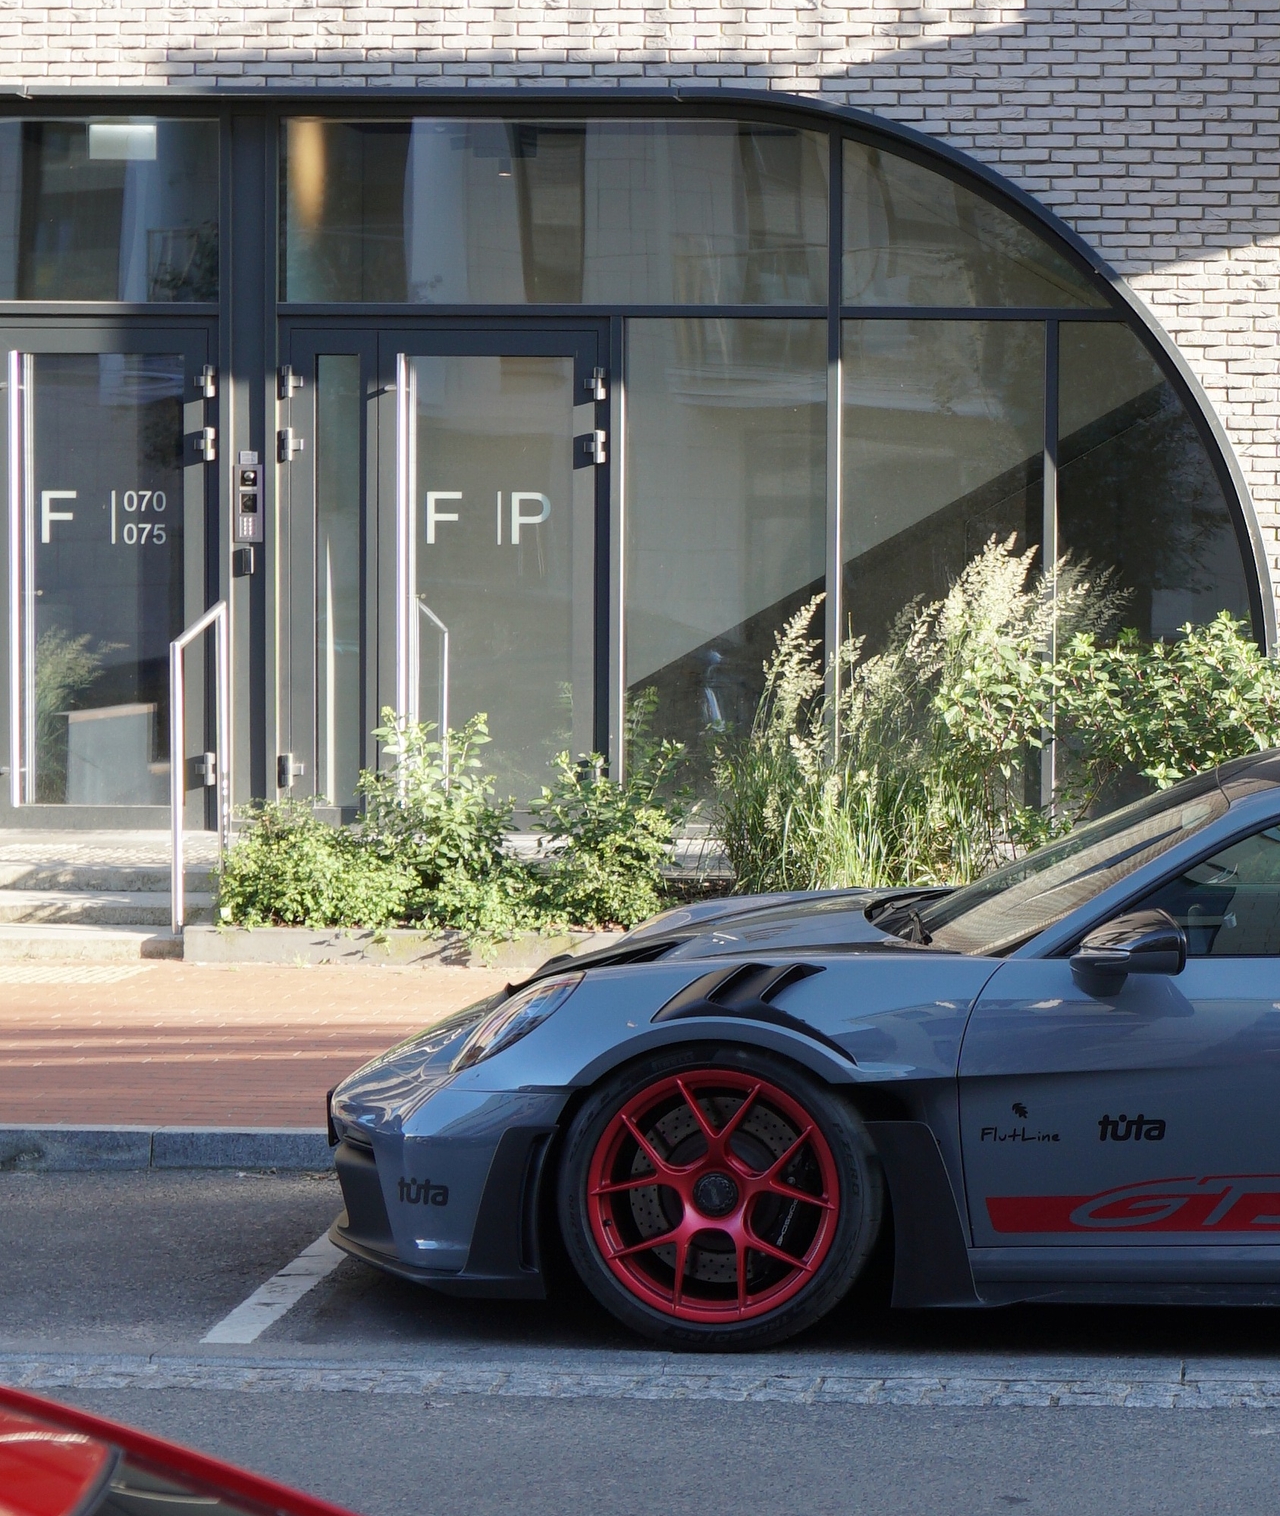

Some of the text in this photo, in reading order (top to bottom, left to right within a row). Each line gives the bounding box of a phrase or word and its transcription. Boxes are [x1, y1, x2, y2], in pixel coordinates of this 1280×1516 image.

[41, 490, 77, 544] F
[124, 491, 167, 512] 070
[426, 491, 462, 545] F
[123, 524, 167, 545] 075
